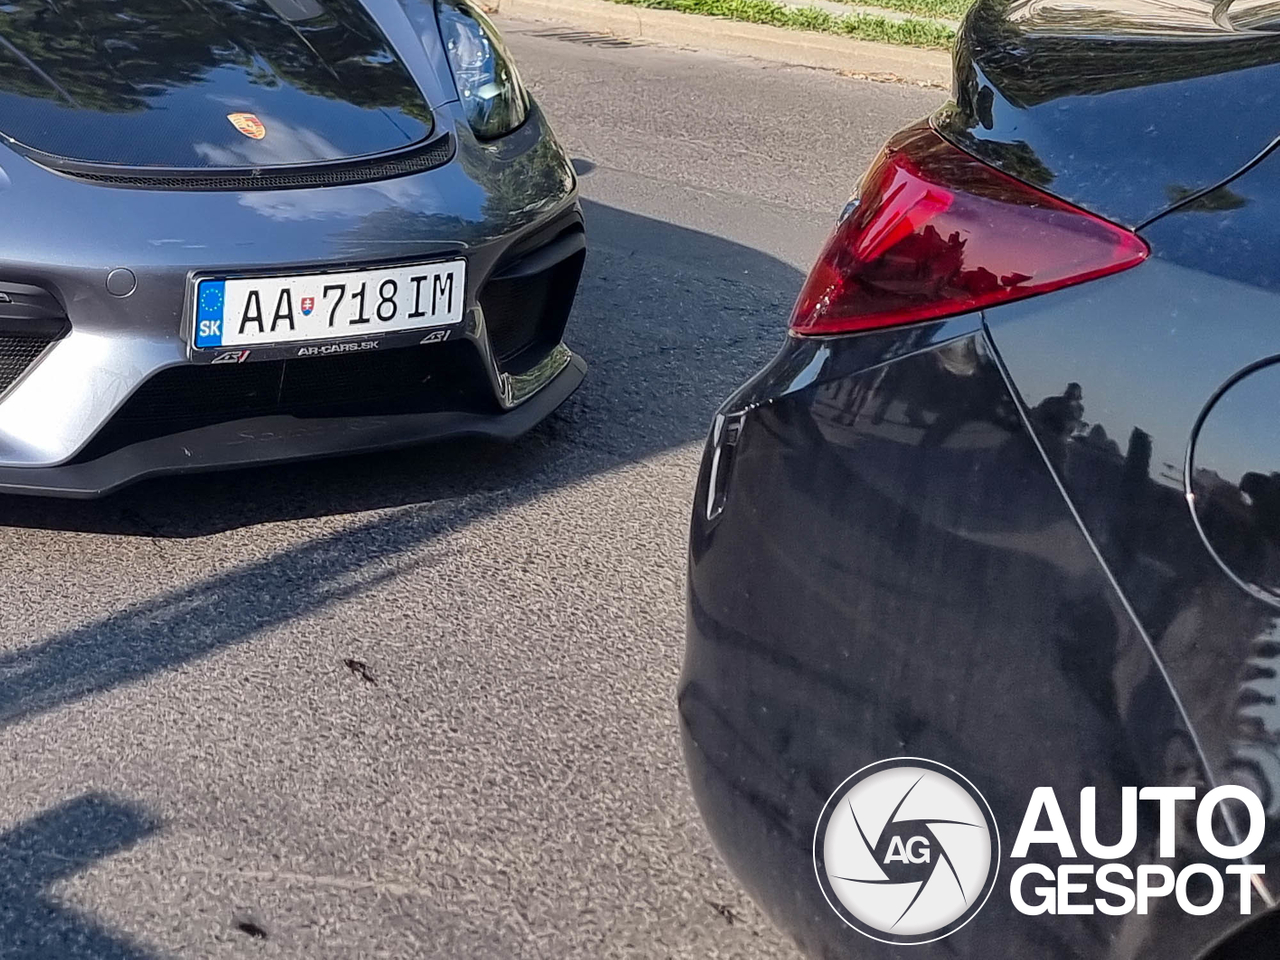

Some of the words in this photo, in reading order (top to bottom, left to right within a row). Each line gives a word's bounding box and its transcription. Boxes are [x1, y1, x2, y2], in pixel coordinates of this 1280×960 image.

[238, 287, 295, 334] AA
[199, 319, 221, 337] SK
[297, 340, 379, 356] AR-CARS.SK
